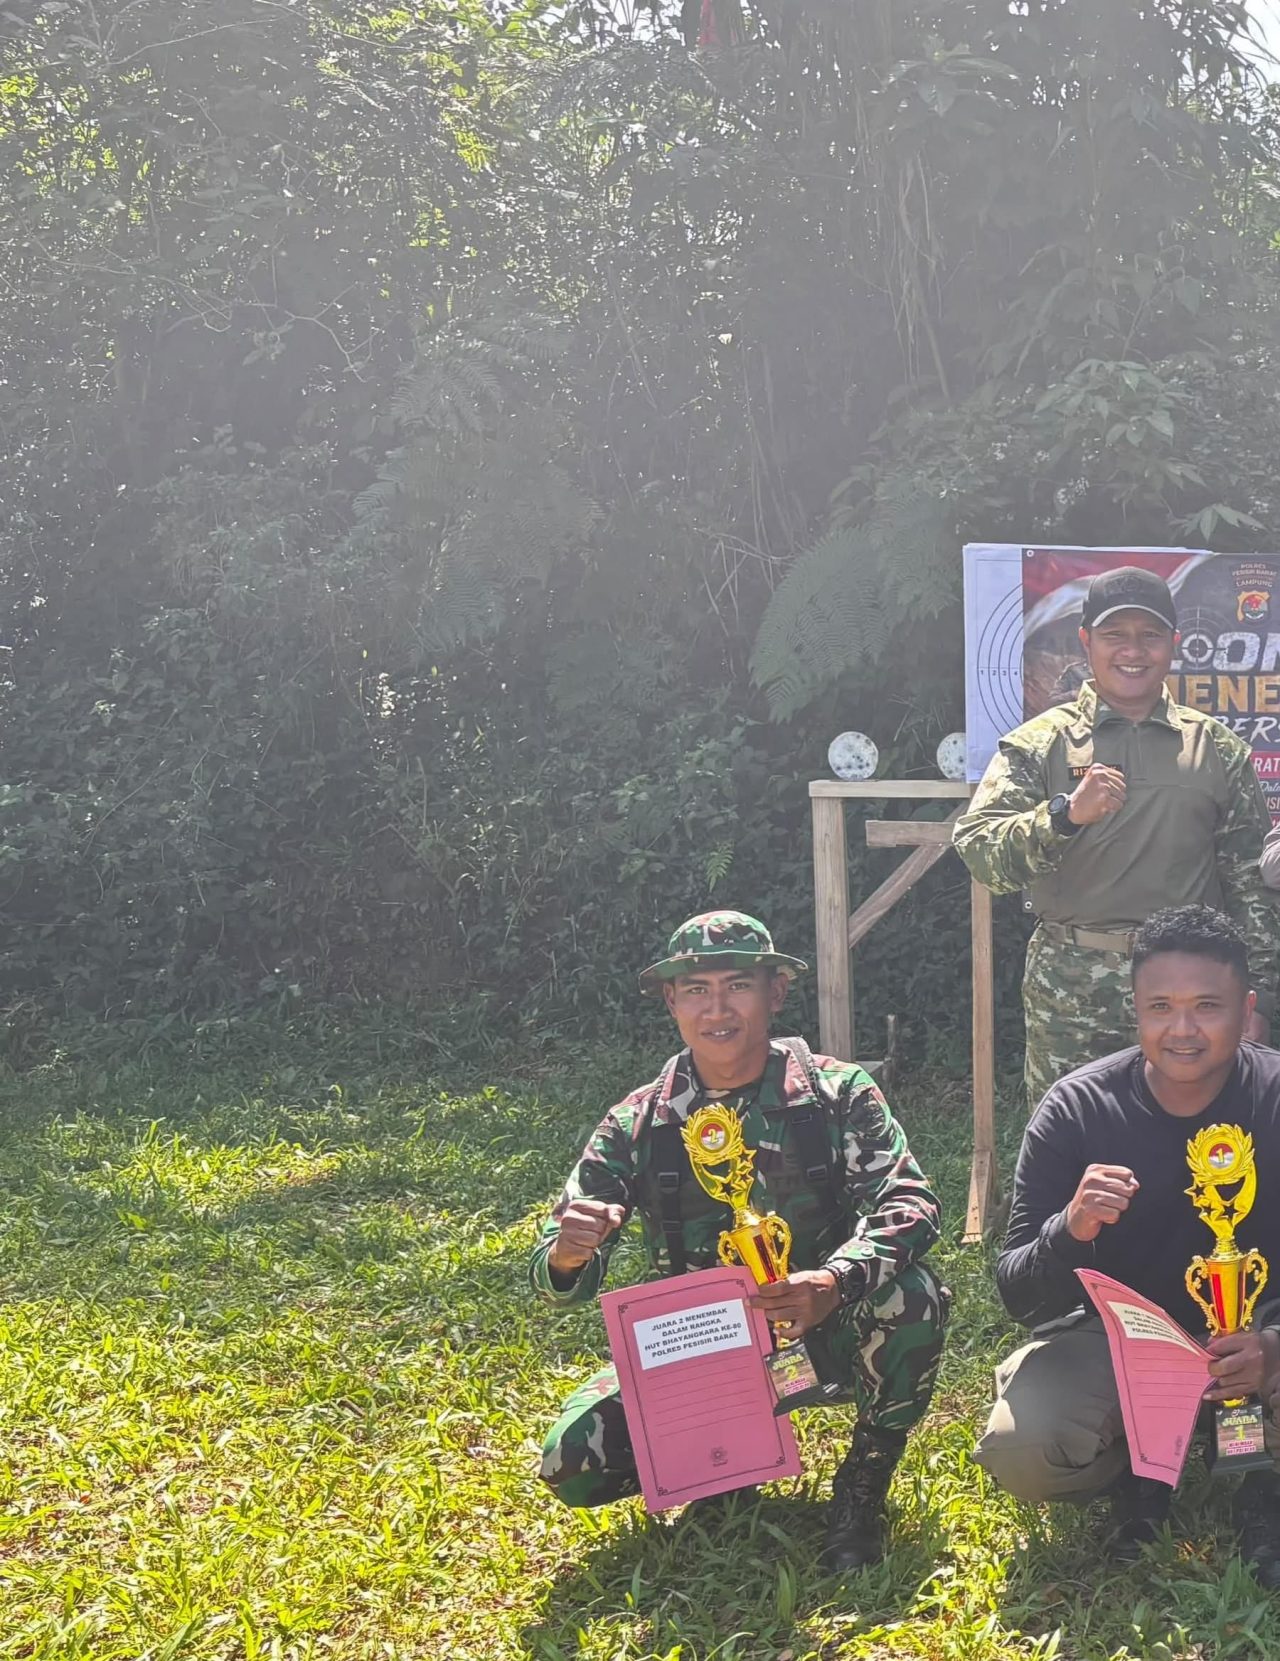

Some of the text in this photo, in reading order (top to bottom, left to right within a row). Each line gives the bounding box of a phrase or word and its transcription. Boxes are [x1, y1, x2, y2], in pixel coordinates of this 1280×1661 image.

[707, 1128, 718, 1143] 2
[652, 1320, 677, 1331] JUARA
[685, 1308, 728, 1322] MENEMBAK
[662, 1318, 722, 1337] DALAM RANGKA
[645, 1342, 660, 1351] HUT
[662, 1328, 720, 1346] BHAYANGKARA
[652, 1332, 738, 1358] POLRES PESISIR BARAT
[772, 1353, 805, 1371] JUARA
[784, 1365, 798, 1380] 2
[1222, 1414, 1258, 1427] JUARA
